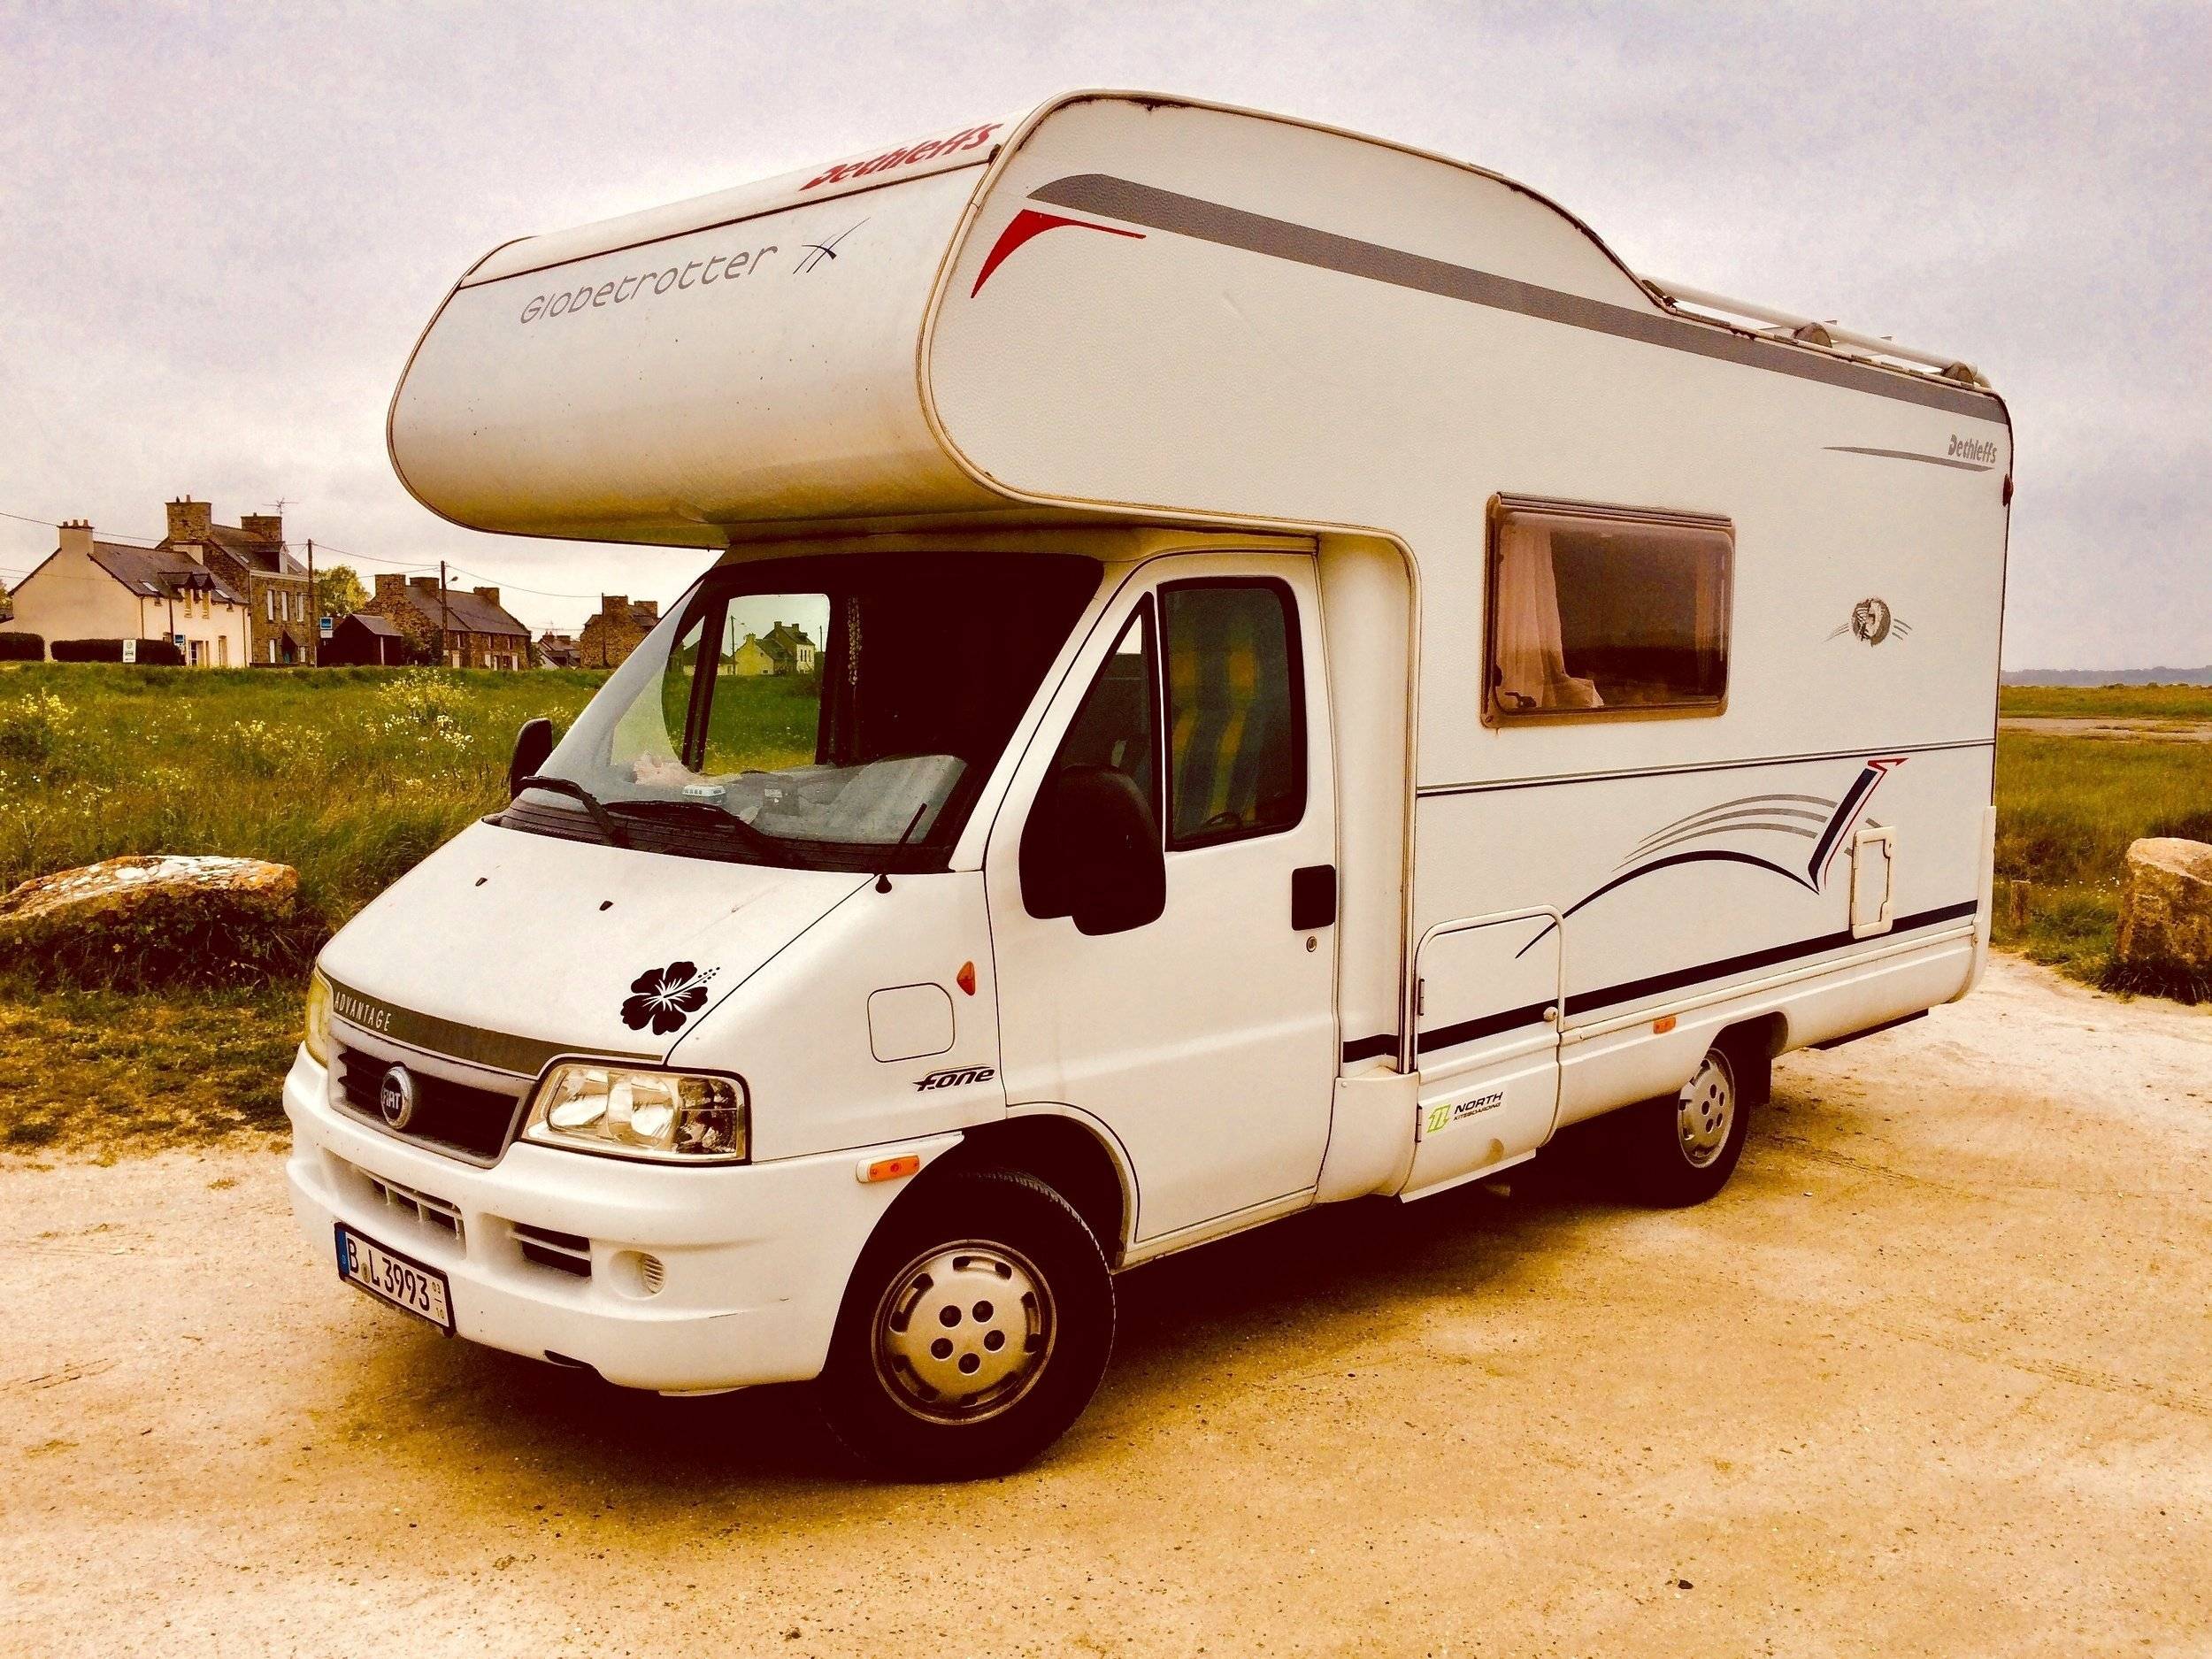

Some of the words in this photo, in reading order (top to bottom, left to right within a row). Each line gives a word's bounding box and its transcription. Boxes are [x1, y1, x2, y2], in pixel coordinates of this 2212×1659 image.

[798, 122, 1003, 192] Dethleffs
[1947, 434, 1997, 464] Dethleffs
[334, 991, 392, 1032] ADVANTAGE
[382, 1087, 401, 1110] FIAT
[1454, 1091, 1503, 1114] NORTH
[347, 1238, 359, 1273] B
[368, 1248, 380, 1287] L
[382, 1256, 430, 1311] 3993
